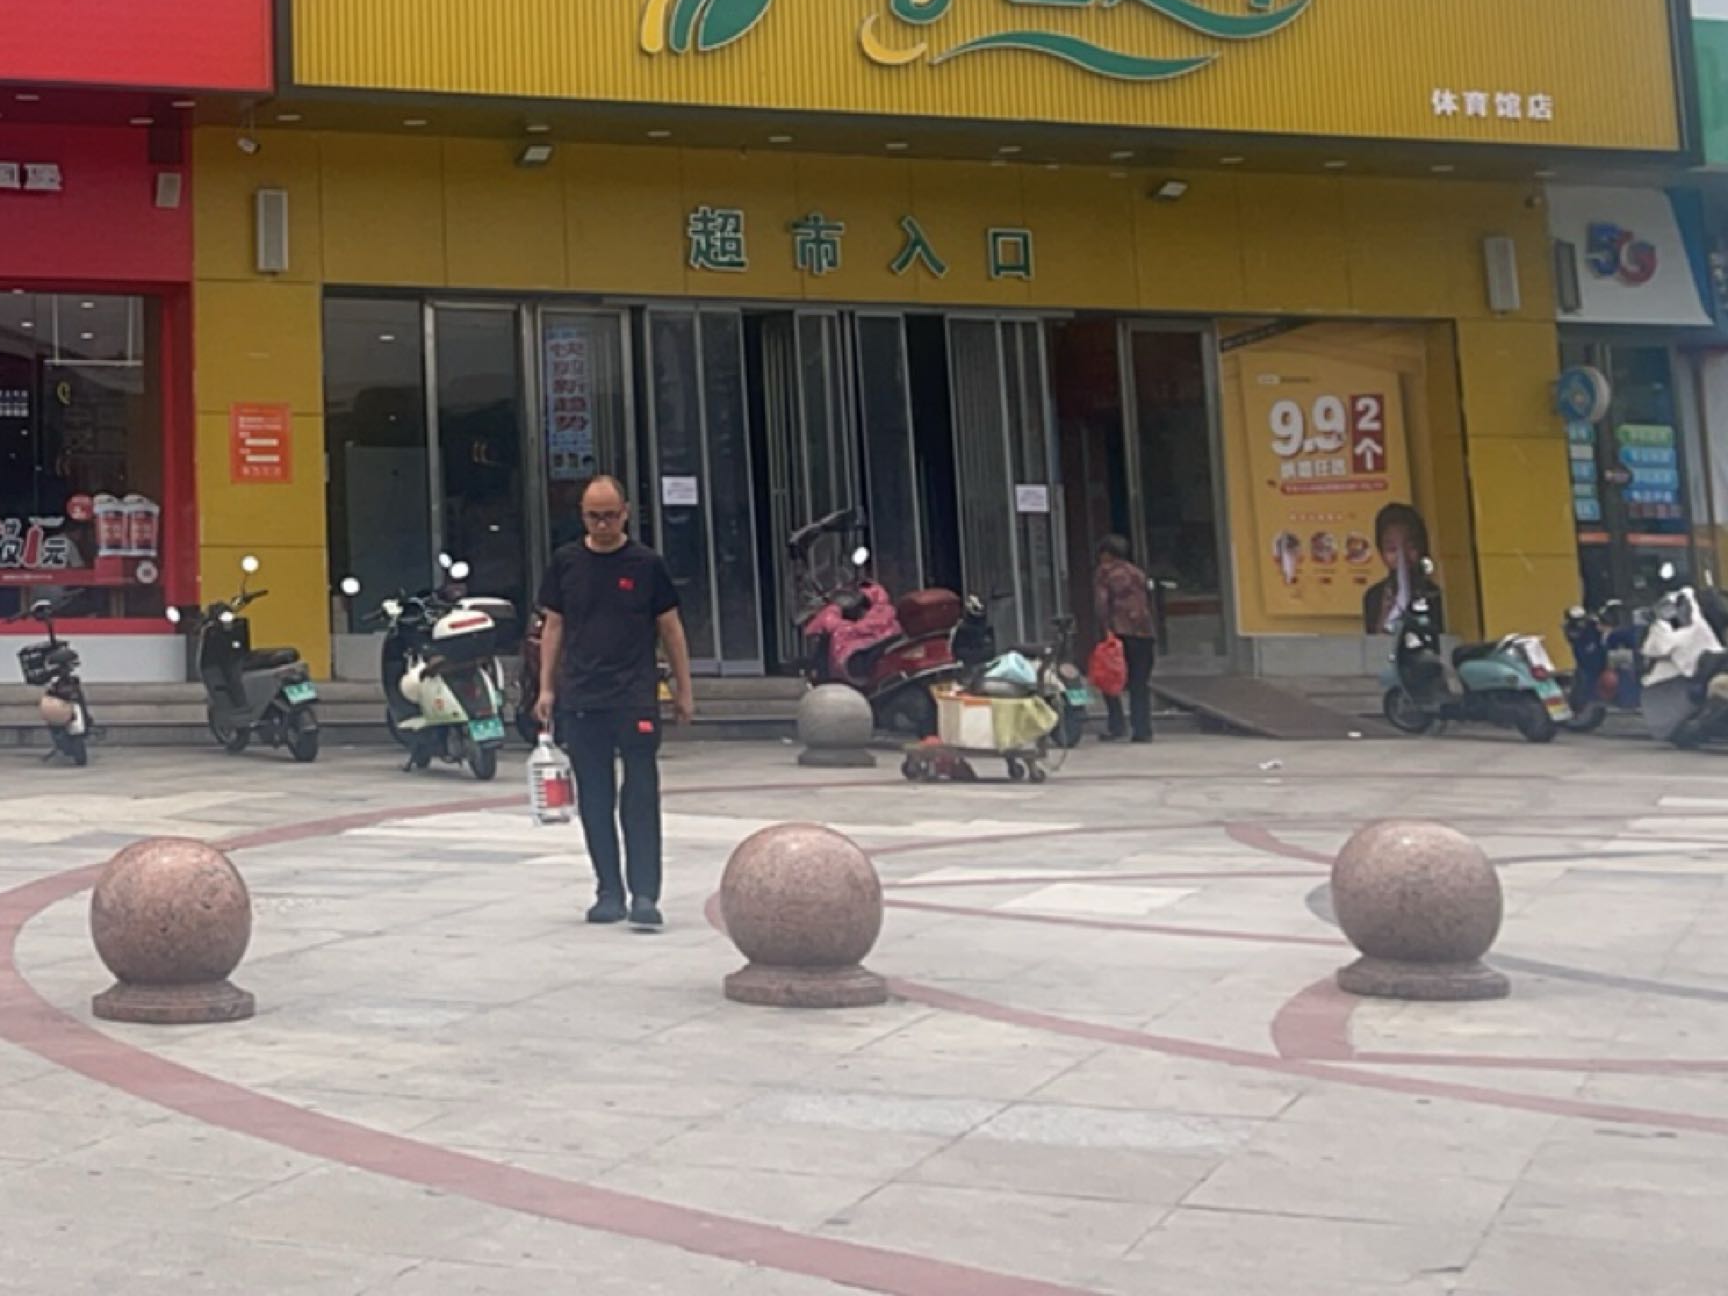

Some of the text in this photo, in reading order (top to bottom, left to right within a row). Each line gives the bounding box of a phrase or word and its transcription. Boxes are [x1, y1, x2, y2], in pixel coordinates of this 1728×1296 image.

[1432, 88, 1552, 121] 体育馆店
[689, 207, 1035, 280] 超市入口
[1268, 394, 1347, 458] 9.9
